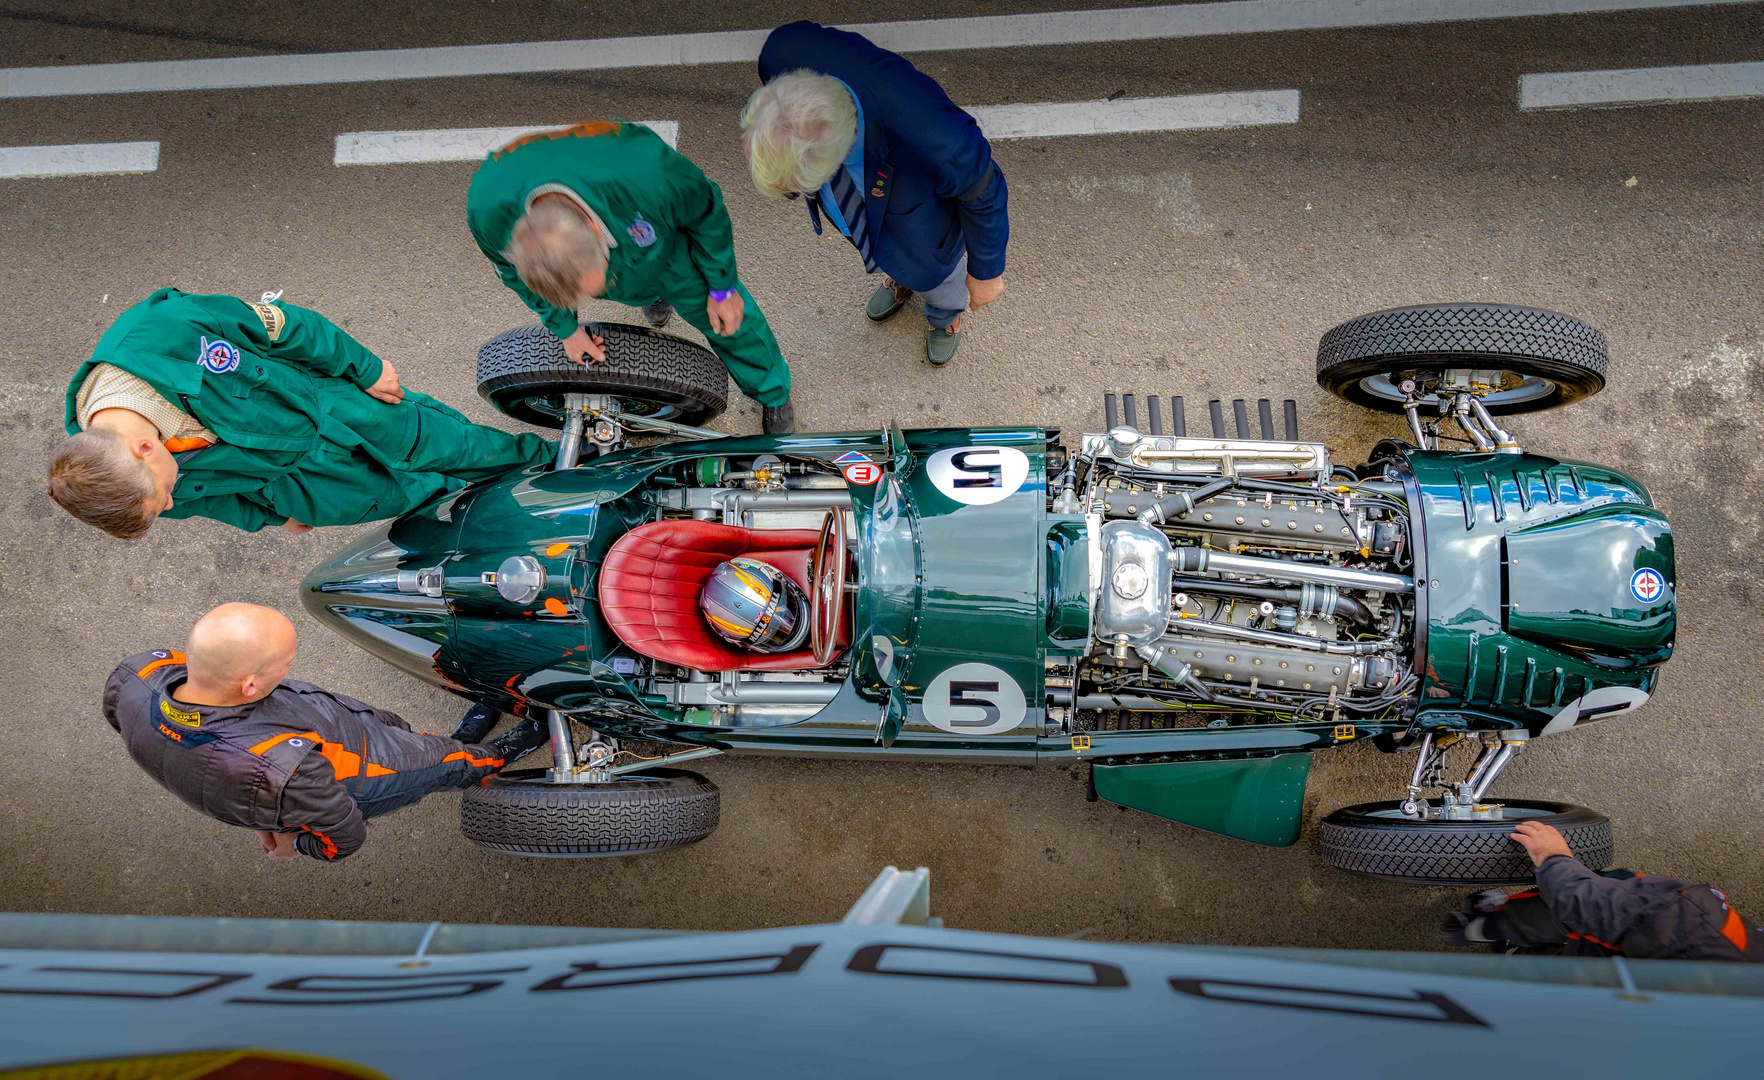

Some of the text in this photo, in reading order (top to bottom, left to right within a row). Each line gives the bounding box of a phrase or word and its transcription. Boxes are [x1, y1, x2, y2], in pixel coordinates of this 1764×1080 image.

[854, 467, 871, 479] E
[950, 449, 1003, 488] 5
[949, 681, 1000, 727] 5
[158, 722, 182, 742] TORQ
[0, 942, 1492, 1029] PORSC
